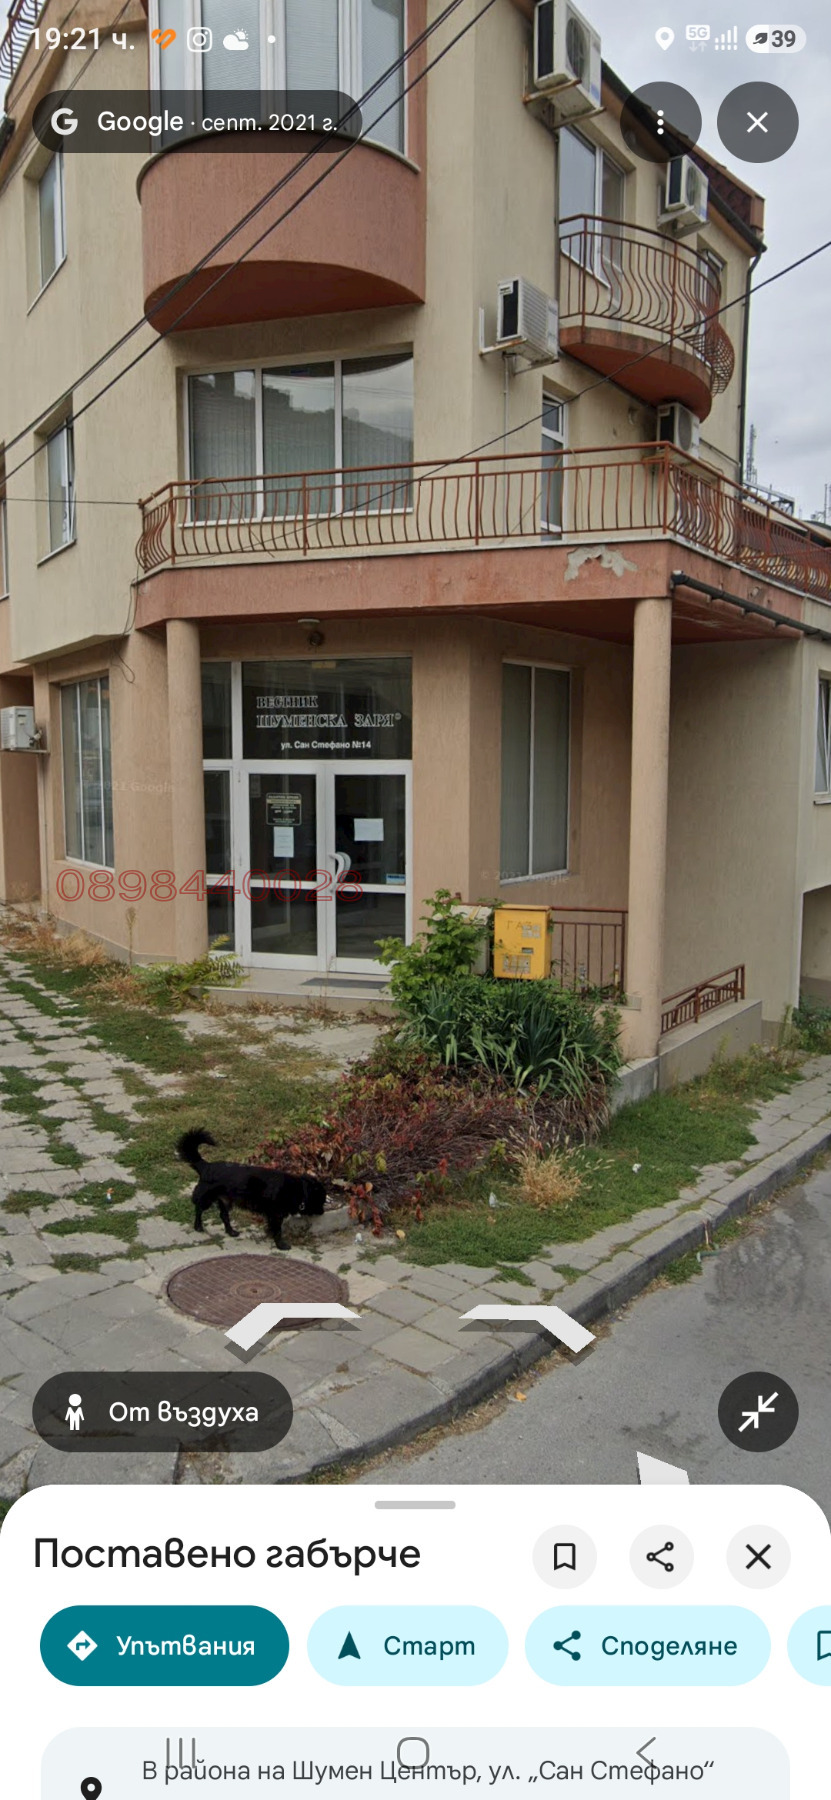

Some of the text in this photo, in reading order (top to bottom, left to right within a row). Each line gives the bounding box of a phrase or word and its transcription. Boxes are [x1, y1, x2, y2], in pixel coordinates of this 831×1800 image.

[256, 695, 319, 709] ВЕСТНИК
[256, 713, 347, 728] ШУМЕНСКА
[280, 740, 372, 751] ул. Сан Стефано №14
